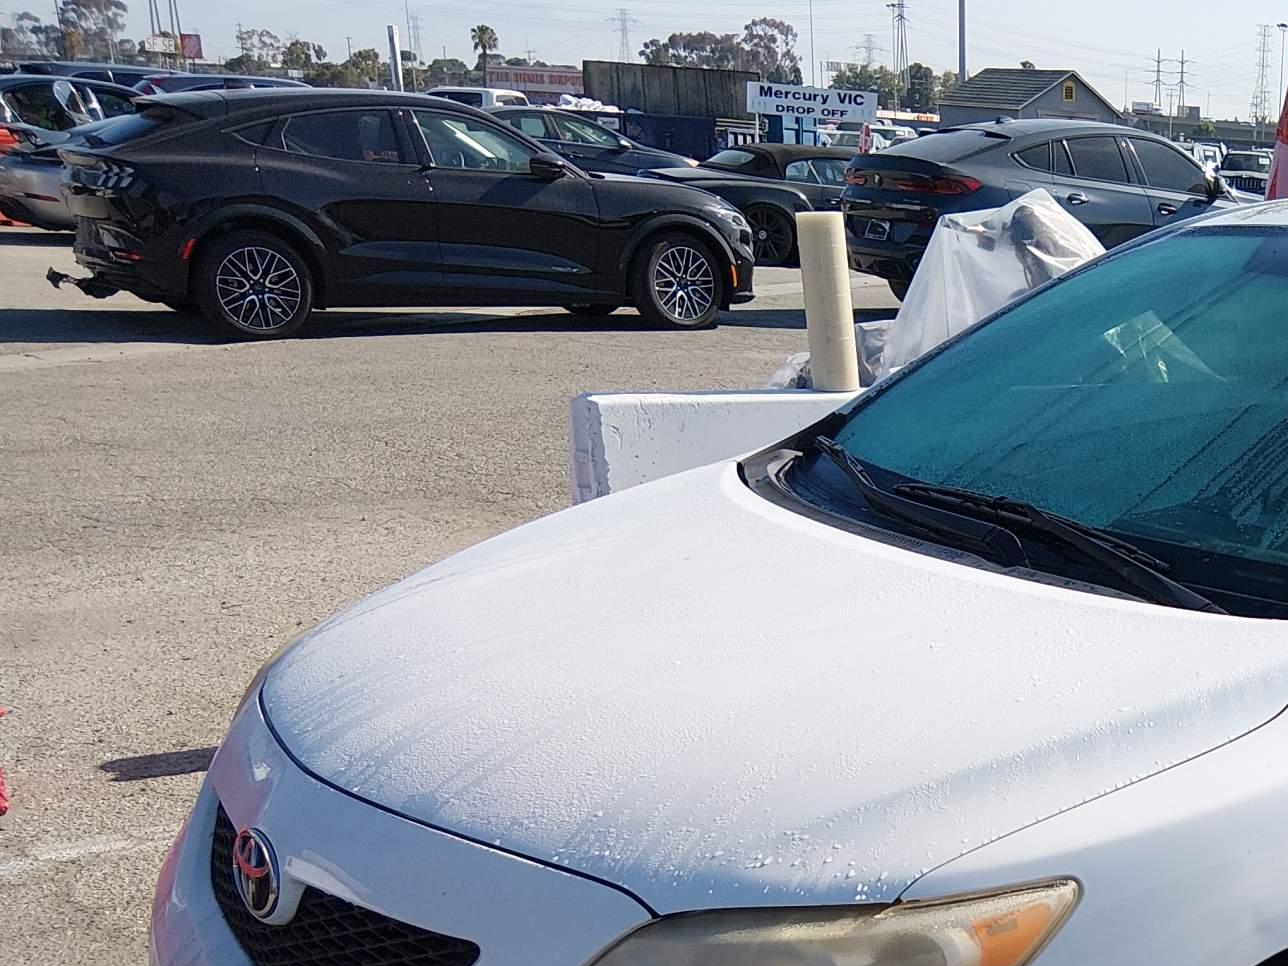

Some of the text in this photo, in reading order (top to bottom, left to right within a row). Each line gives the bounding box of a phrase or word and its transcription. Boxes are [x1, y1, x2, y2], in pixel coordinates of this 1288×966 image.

[759, 86, 829, 106] Mercury
[775, 104, 849, 119] DROP OFF
